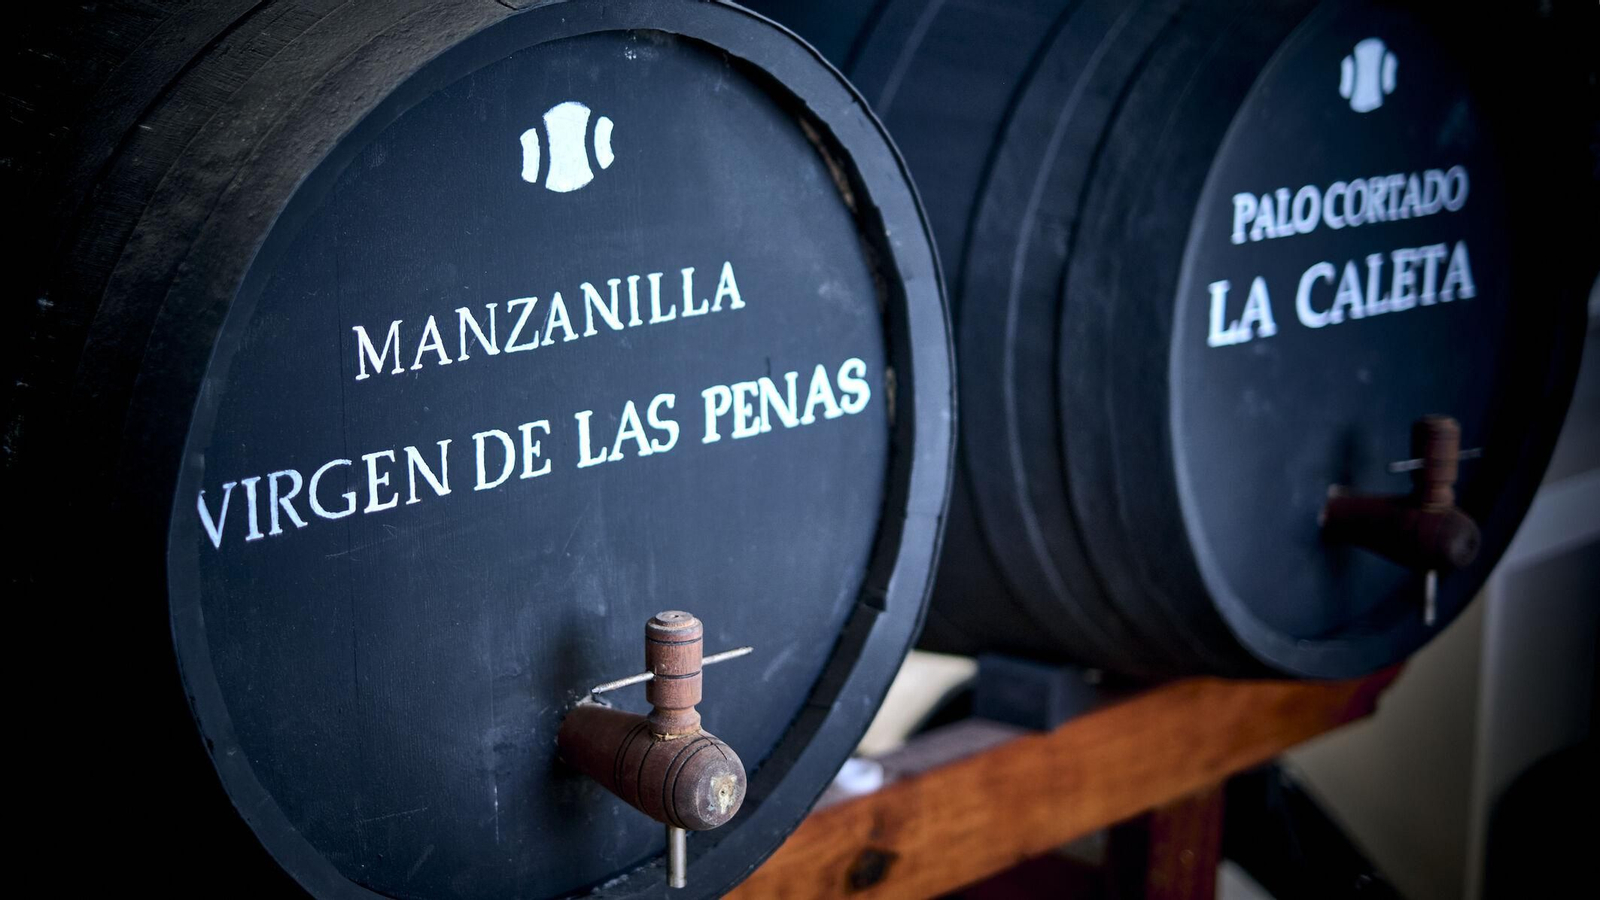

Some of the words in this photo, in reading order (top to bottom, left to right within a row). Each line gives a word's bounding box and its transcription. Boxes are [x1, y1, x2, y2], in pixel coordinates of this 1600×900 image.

[1231, 184, 1322, 245] PALO
[1321, 164, 1470, 230] CORTADO
[352, 260, 747, 381] MANZANILLA
[1207, 275, 1277, 348] LA
[1295, 239, 1477, 329] CALETA
[196, 438, 453, 550] VIRGEN
[472, 419, 552, 493] DE
[573, 392, 681, 470] LAS
[701, 357, 872, 445] PENAS
